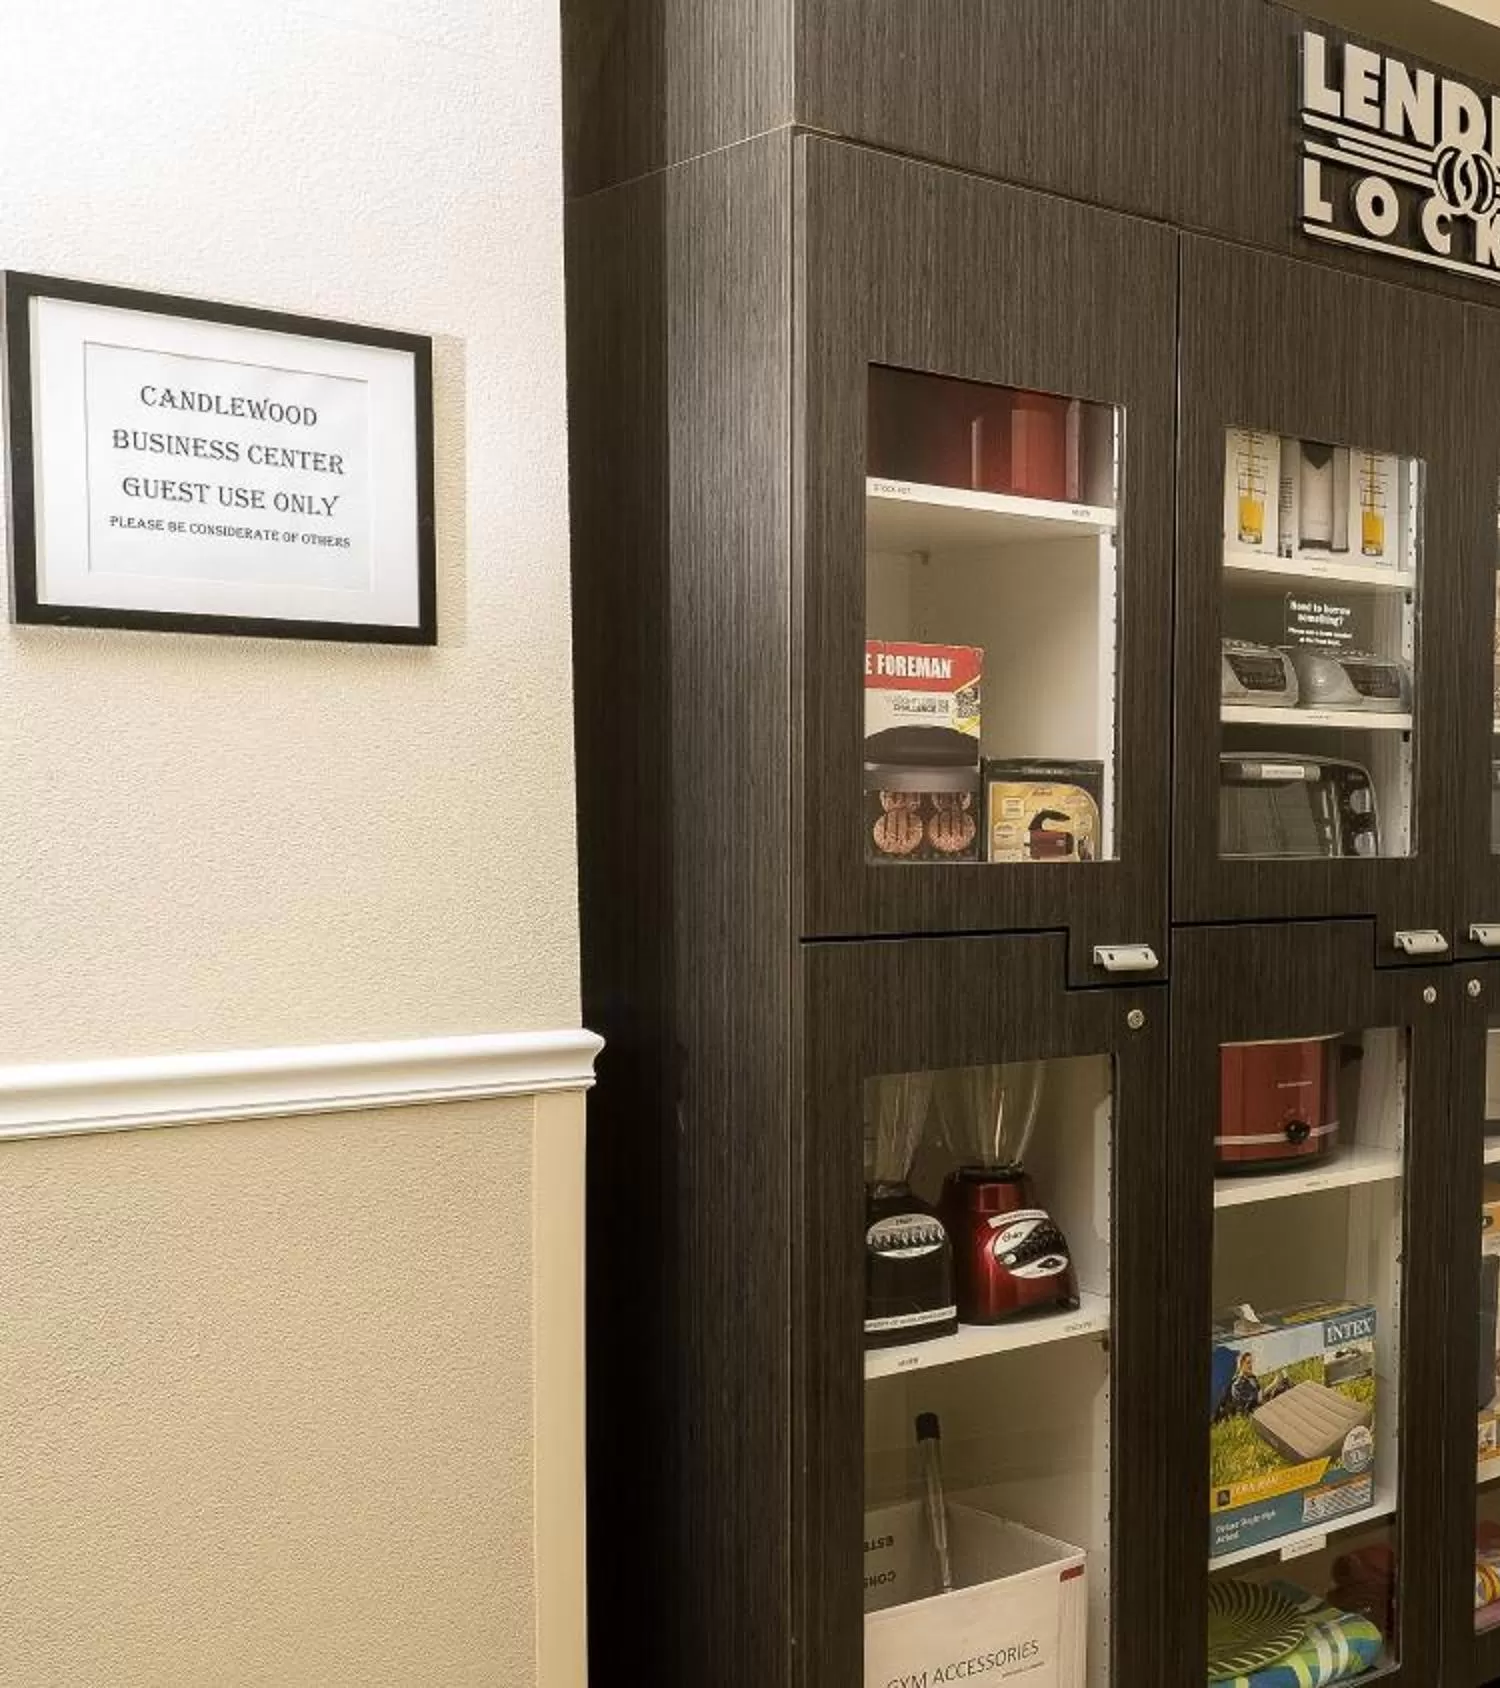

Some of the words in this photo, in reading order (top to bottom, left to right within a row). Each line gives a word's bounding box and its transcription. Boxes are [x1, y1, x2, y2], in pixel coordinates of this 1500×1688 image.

[140, 385, 318, 426] CANDLEWOOD
[112, 428, 240, 462] BUSINESS
[247, 444, 344, 474] CENTER
[122, 476, 211, 504] GUEST
[218, 485, 266, 509] USE
[273, 491, 340, 517] ONLY
[109, 515, 164, 531] PLEASE
[167, 521, 187, 533] BE
[189, 523, 280, 542] CONSIDERATE
[283, 531, 298, 543] OF
[301, 533, 350, 548] OTHERS
[876, 654, 952, 679] FOREMAN
[1327, 1317, 1374, 1343] INTEX
[932, 1639, 1040, 1685] ACCESSORIES
